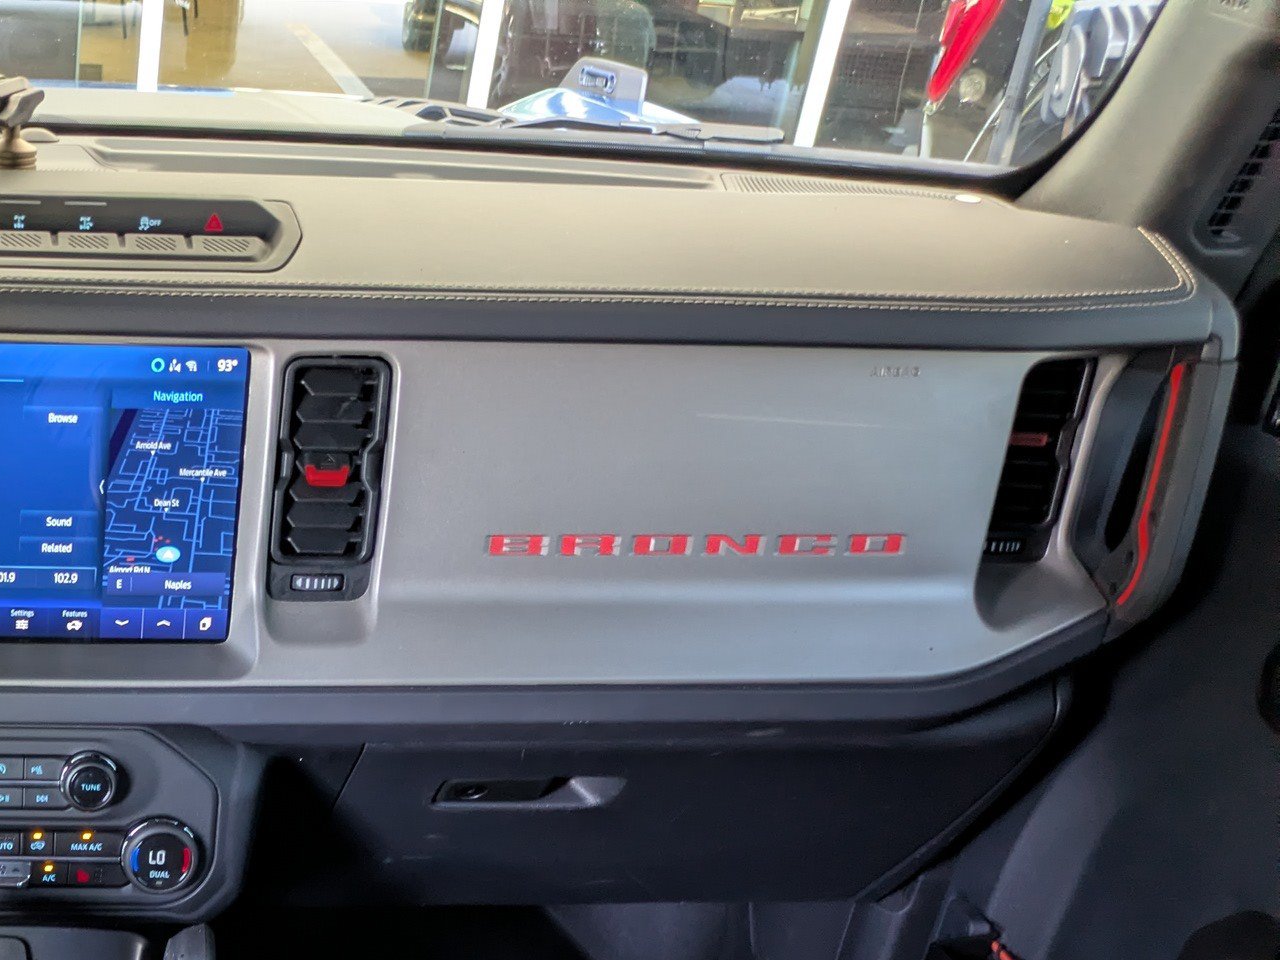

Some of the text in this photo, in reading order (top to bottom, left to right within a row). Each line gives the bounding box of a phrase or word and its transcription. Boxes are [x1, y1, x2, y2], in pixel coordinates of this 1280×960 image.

[217, 358, 238, 372] 93°
[153, 390, 203, 404] Navigation
[48, 412, 78, 424] Browse
[135, 440, 172, 450] Arnold Ave
[179, 468, 227, 478] Mercantile Ave
[154, 498, 180, 508] Dean St
[46, 516, 72, 528] Sound
[42, 542, 72, 554] Related
[487, 532, 906, 556] BRONCO
[54, 573, 78, 584] 102.9
[116, 578, 122, 590] E
[164, 580, 192, 590] Naples
[10, 608, 34, 618] Settings
[62, 610, 88, 618] Features
[81, 784, 102, 792] TUNE
[70, 842, 103, 851] MAX A/C
[148, 850, 166, 866] LO
[42, 874, 56, 882] A/C
[150, 870, 170, 879] DUAL
